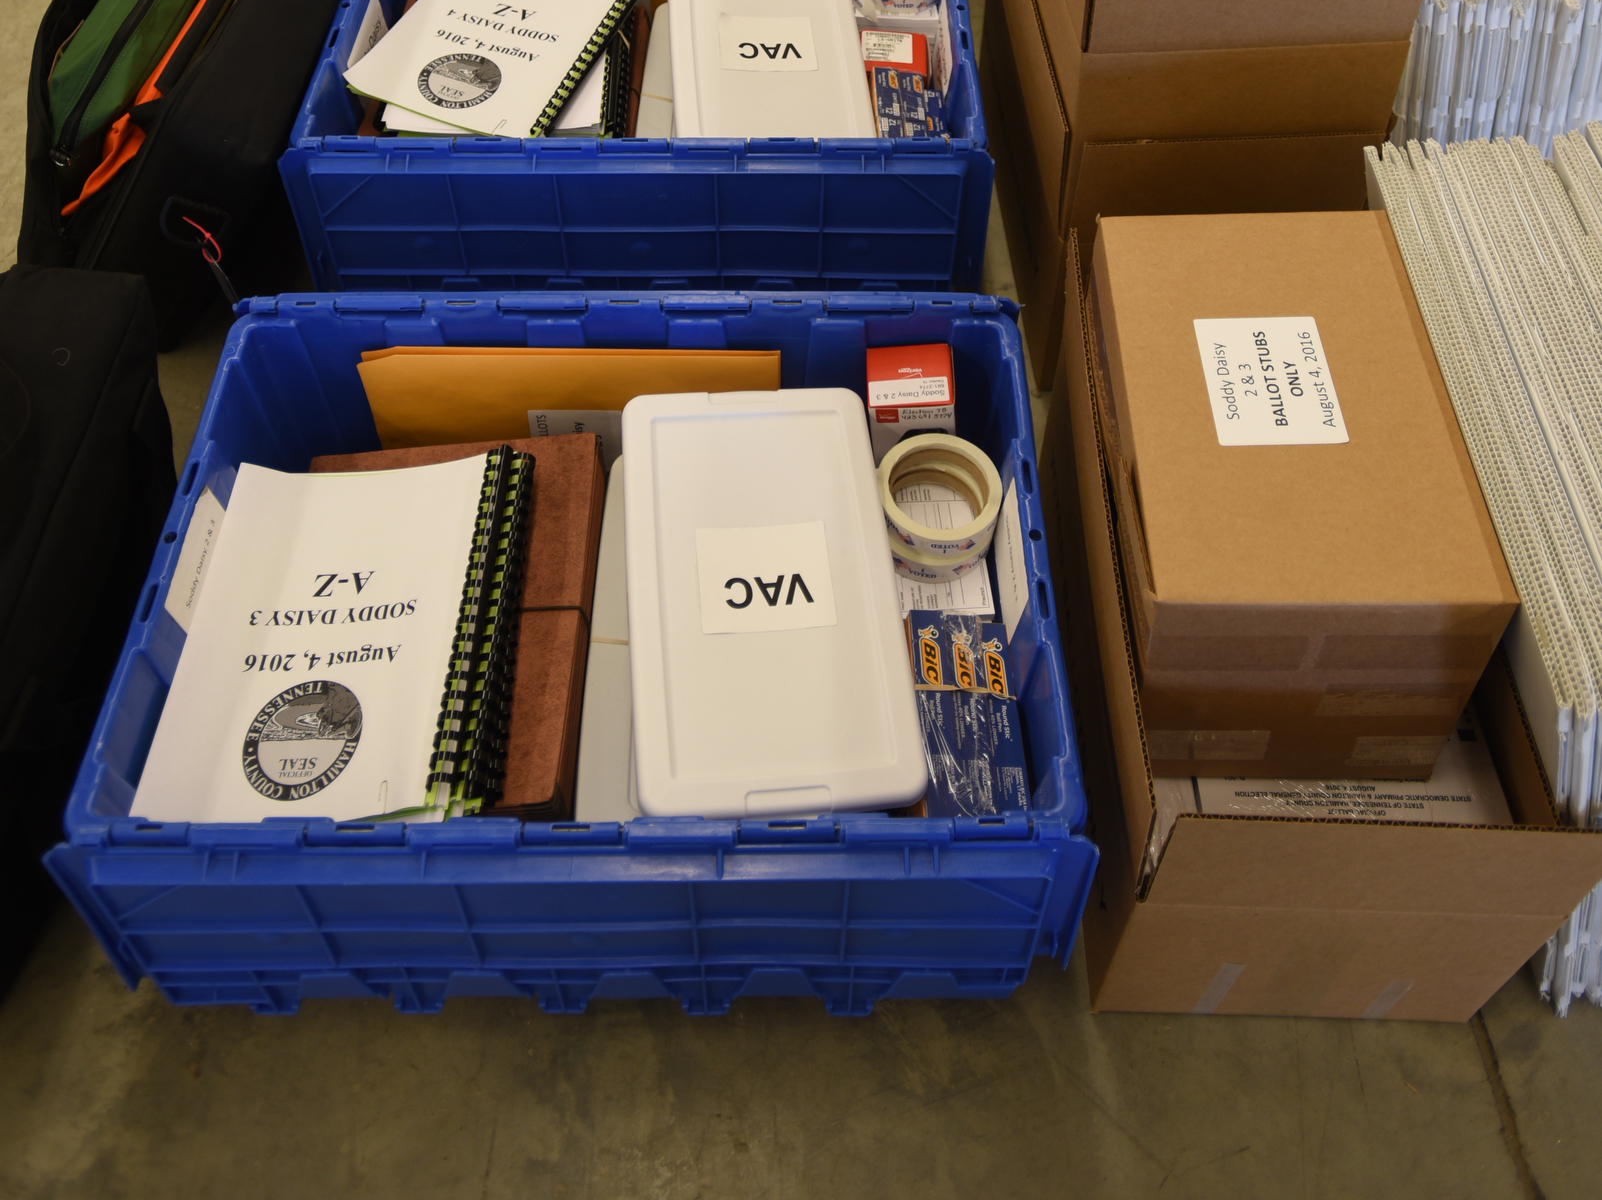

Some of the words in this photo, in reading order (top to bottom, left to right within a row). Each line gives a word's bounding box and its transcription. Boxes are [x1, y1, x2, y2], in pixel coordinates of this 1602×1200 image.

[447, 9, 456, 17] 4
[492, 3, 537, 21] A-Z
[457, 13, 505, 31] DAISY
[435, 29, 471, 46] 2016
[475, 38, 486, 49] 4,
[505, 26, 560, 43] SODDY
[488, 44, 540, 62] August
[738, 42, 802, 59] VAC
[425, 54, 482, 72] TENNESSEE
[418, 76, 439, 103] COUNTY
[440, 85, 465, 97] SEAL
[441, 91, 493, 109] HAMILTON
[1252, 331, 1274, 372] STUBS
[1297, 332, 1318, 362] 2016
[1214, 342, 1230, 376] Daisy
[1238, 363, 1252, 371] 3
[1241, 375, 1255, 385] &
[1283, 361, 1304, 397] ONLY
[1308, 366, 1323, 378] 4,
[1220, 380, 1240, 420] Soddy
[1244, 389, 1258, 397] 2
[1263, 375, 1288, 426] BALLOT
[1313, 382, 1336, 427] August
[205, 538, 210, 546] 2
[207, 529, 213, 537] &
[196, 548, 208, 575] Daisy
[909, 569, 937, 579] VOTED
[186, 577, 199, 609] Soddy
[312, 571, 375, 597] A-Z
[724, 573, 815, 609] VAC
[249, 610, 262, 626] 3
[264, 609, 338, 626] DAISY
[341, 599, 417, 624] SODDY
[242, 654, 296, 672] 2016
[304, 650, 321, 671] 4,
[326, 644, 402, 668] August
[924, 642, 939, 683] BIC
[988, 655, 1004, 694] BIC
[247, 682, 323, 741] TENNESSEE
[1001, 705, 1009, 725] Round
[279, 757, 317, 771] SEAL
[288, 741, 357, 799] HAMILTON
[243, 755, 283, 798] COUNTY
[1350, 801, 1392, 809] TENNESSEE,
